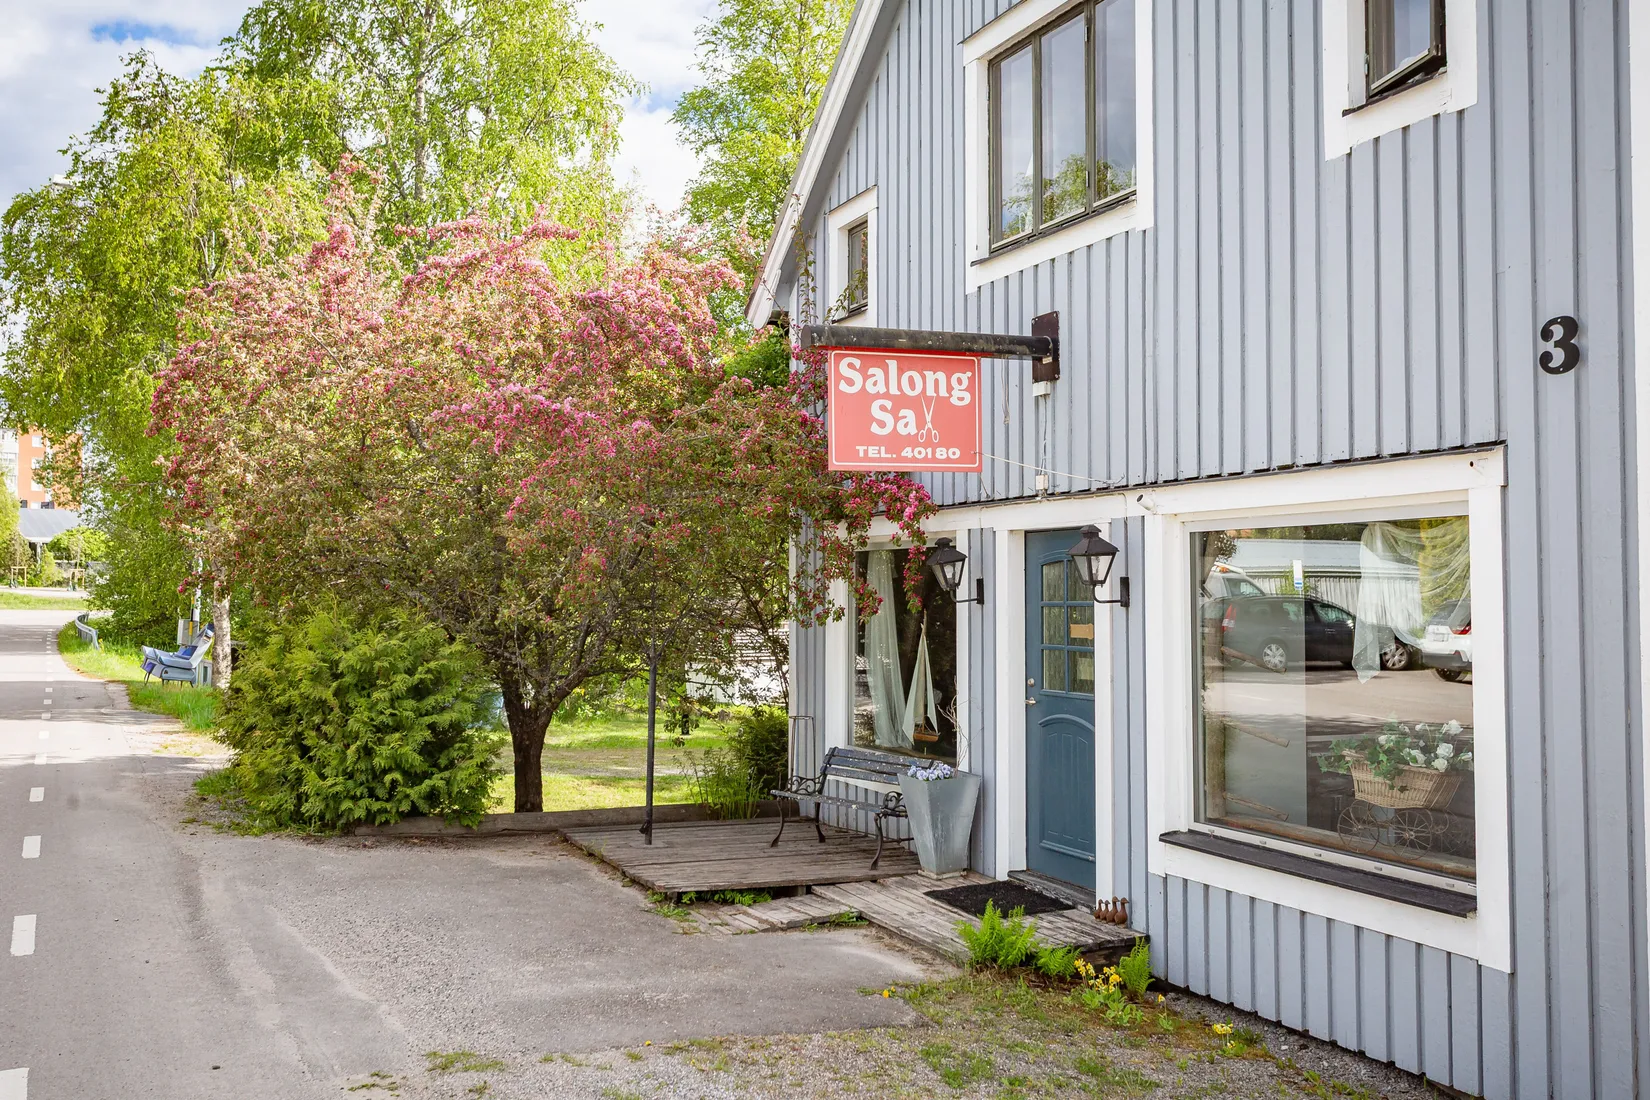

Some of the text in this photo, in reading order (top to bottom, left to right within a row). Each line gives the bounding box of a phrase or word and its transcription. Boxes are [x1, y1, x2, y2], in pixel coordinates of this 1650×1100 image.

[1539, 315, 1580, 375] 3
[838, 357, 972, 406] Salong
[855, 446, 961, 459] TEL. 40180
